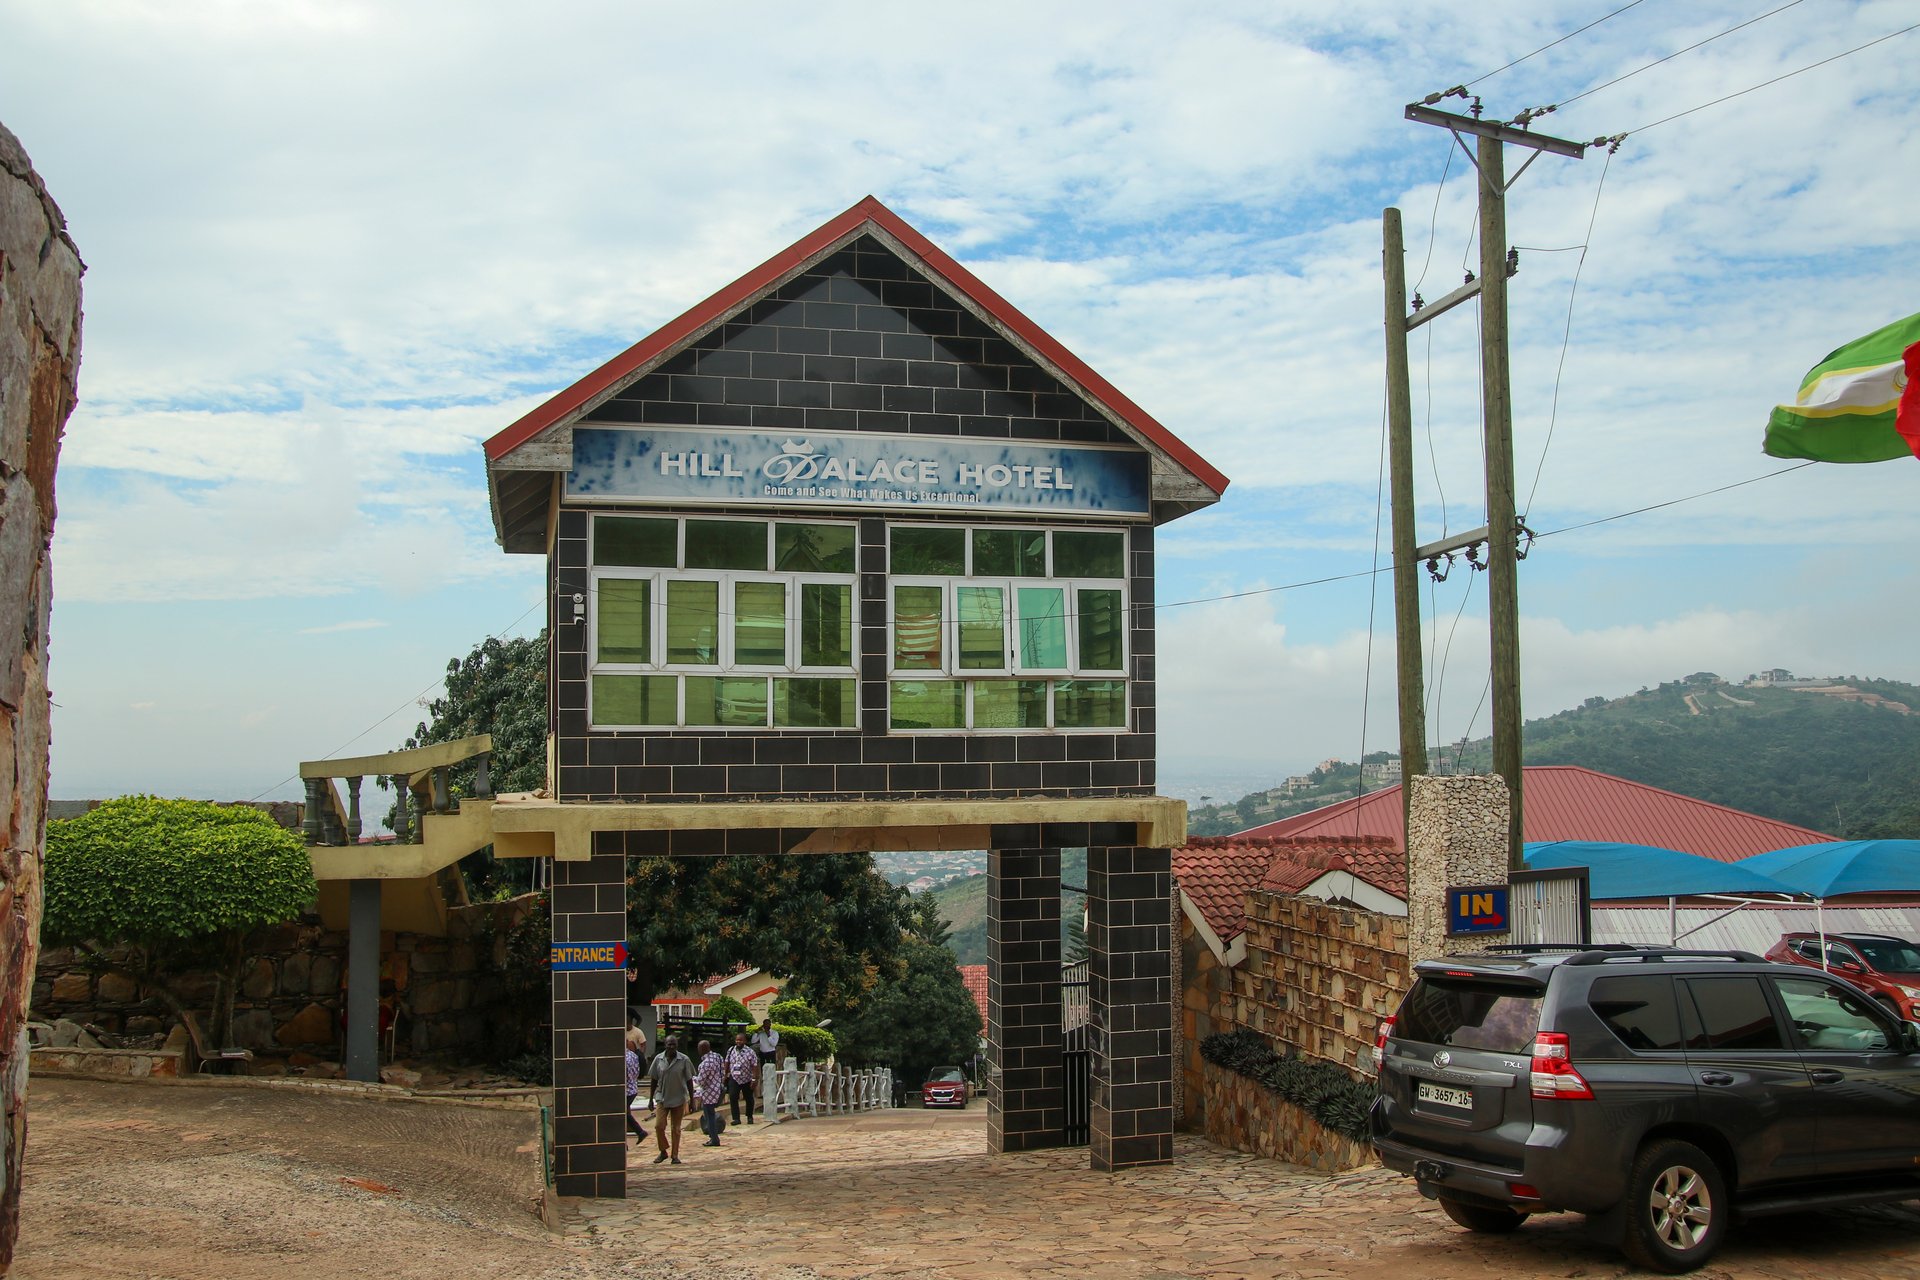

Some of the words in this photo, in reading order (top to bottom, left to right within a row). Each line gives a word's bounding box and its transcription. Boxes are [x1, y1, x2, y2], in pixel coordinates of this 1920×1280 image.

[660, 451, 743, 477] HILL
[763, 453, 940, 485] PALACE
[958, 462, 1074, 490] HOTEL
[764, 484, 794, 497] Come
[796, 486, 816, 497] and
[818, 486, 838, 498] See
[840, 487, 867, 499] What
[869, 488, 903, 500] Makes
[905, 490, 918, 501] Us
[1460, 893, 1493, 917] IN
[550, 947, 615, 963] ENTRANCE
[1419, 1086, 1430, 1098] GW
